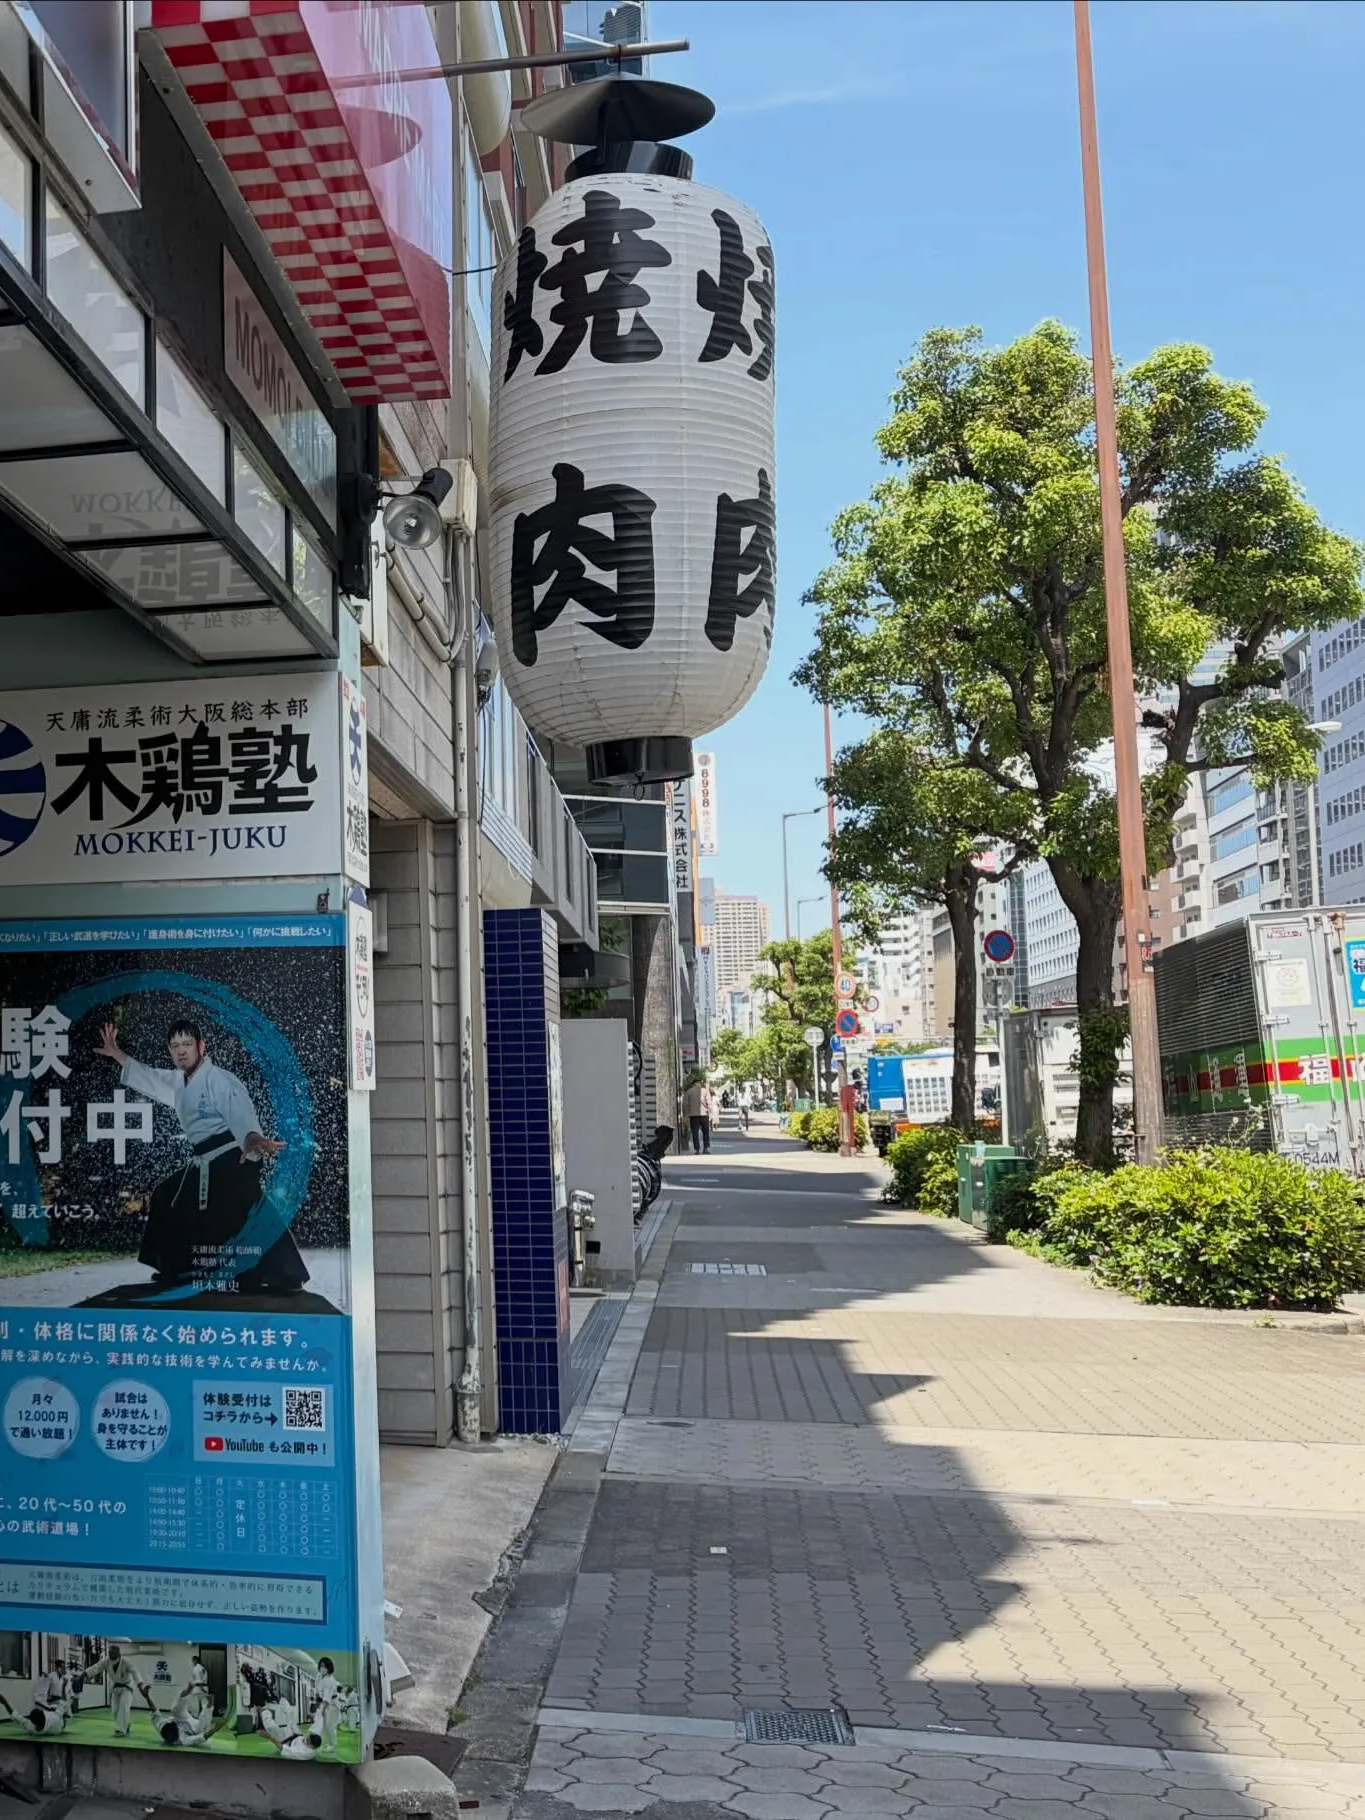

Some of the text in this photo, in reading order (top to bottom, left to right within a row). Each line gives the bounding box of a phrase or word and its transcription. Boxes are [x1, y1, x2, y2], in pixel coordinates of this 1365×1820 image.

[504, 190, 672, 667] 焼肉
[45, 698, 309, 733] 天庸流柔術大阪総本部
[50, 720, 318, 829] 木鶏塾
[74, 825, 287, 856] MOKKEI-JUKU
[11, 1203, 100, 1220] 超えていこう。
[31, 1394, 53, 1406] 月々
[114, 1392, 148, 1404] 試合は
[203, 1392, 272, 1408] 体験受付は
[203, 1410, 264, 1424] コチラから
[97, 1423, 167, 1436] 身を守ることが
[225, 1438, 265, 1453] YouTube
